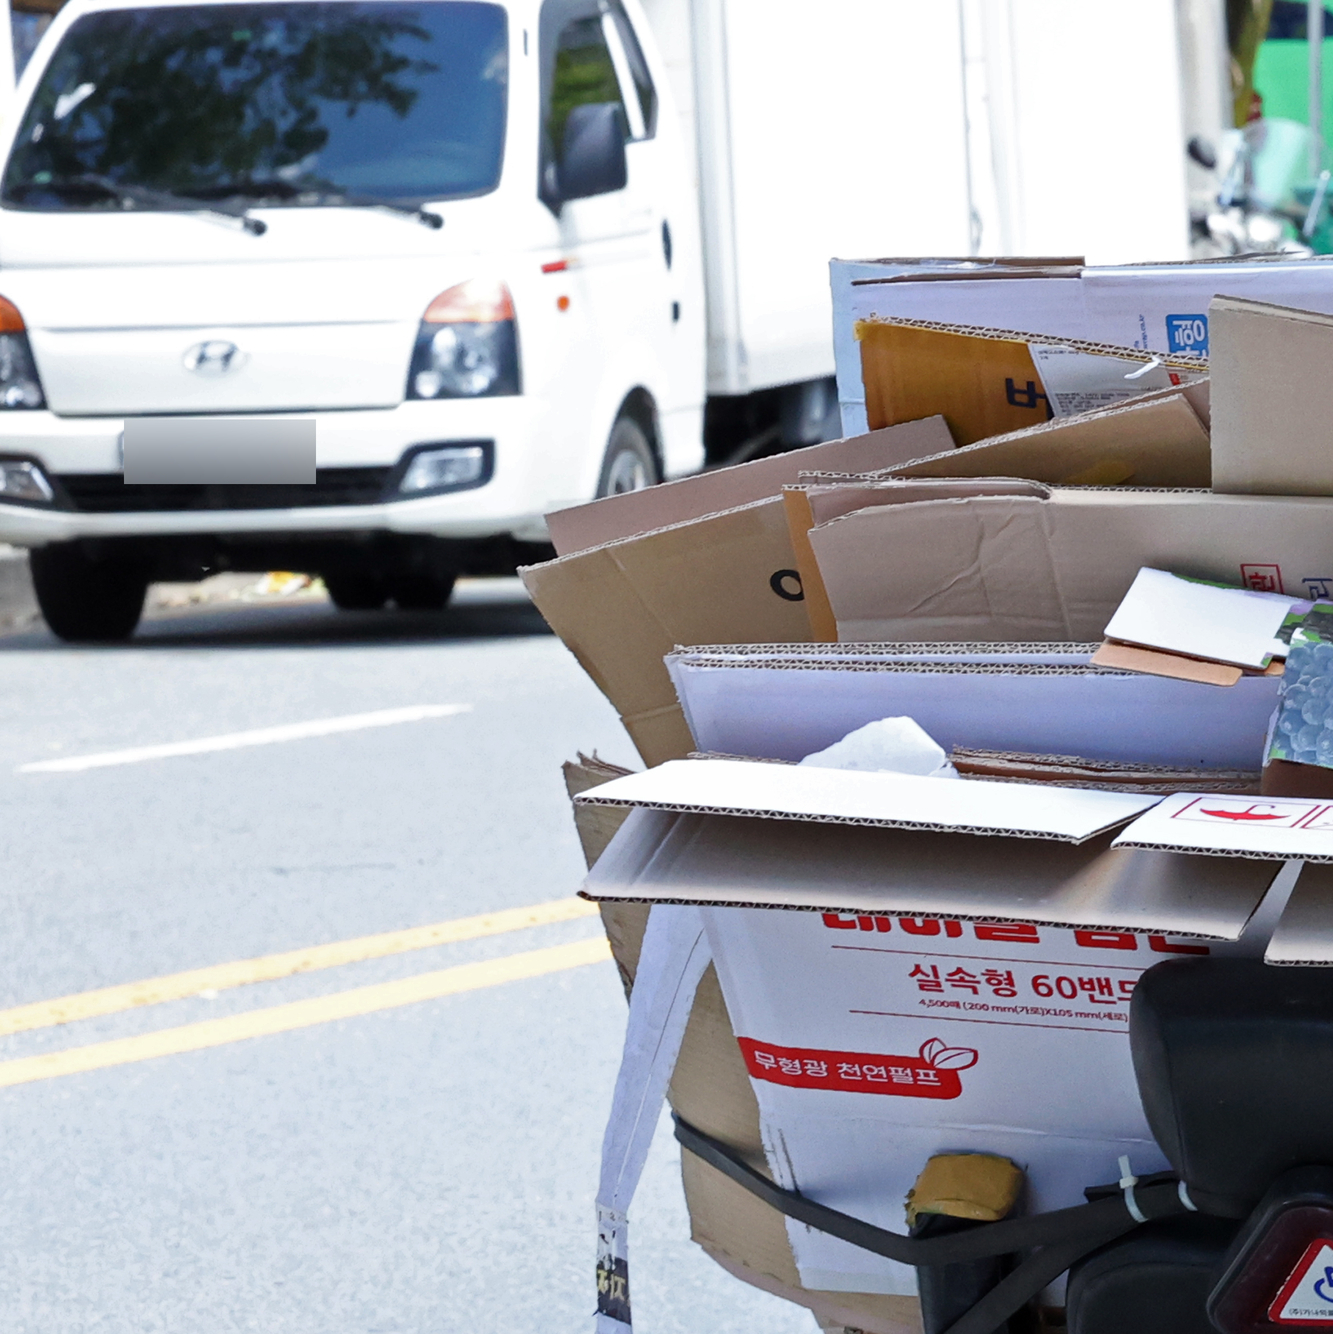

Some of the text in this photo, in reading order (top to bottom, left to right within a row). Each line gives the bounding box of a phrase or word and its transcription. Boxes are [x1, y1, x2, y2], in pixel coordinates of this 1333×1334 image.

[908, 964, 1018, 998] 실속형
[754, 1050, 941, 1086] 무형광 천연펄프
